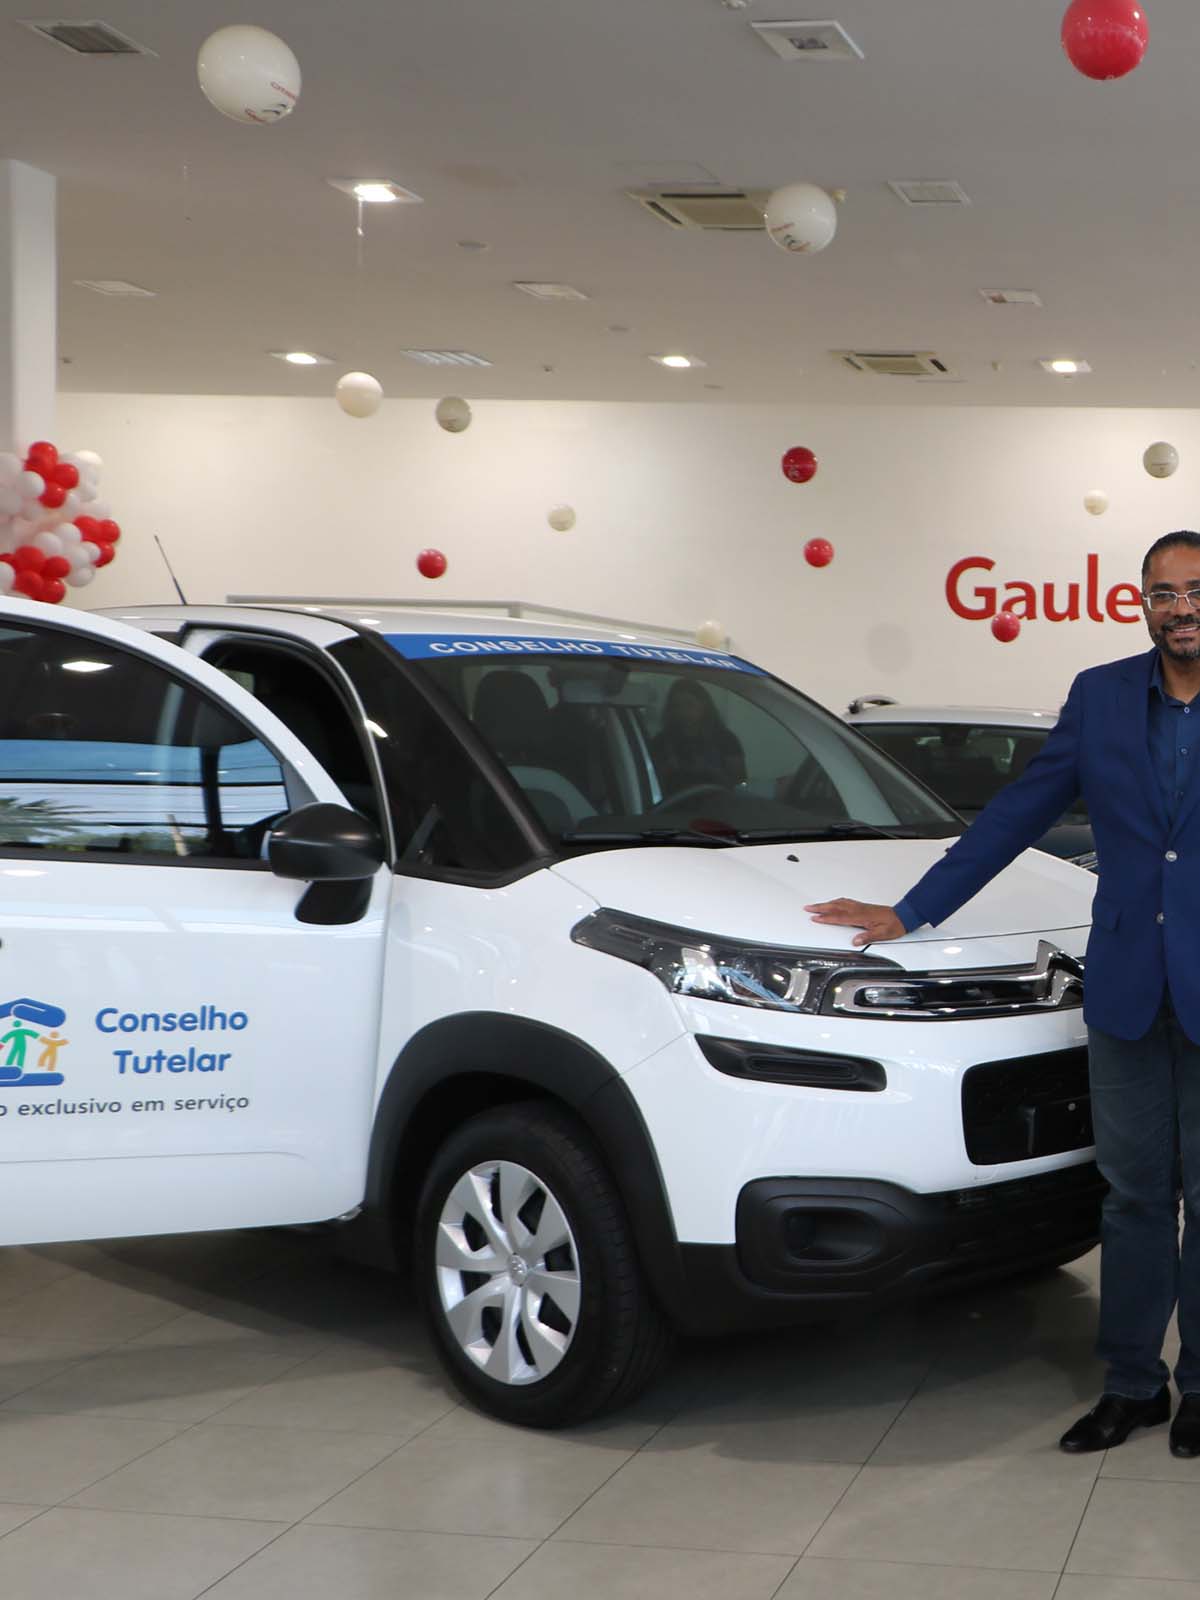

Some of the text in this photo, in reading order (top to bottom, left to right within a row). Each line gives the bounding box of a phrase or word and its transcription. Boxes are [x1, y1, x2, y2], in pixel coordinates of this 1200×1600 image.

[430, 639, 743, 671] CONSELHO TUTELAR
[95, 1004, 249, 1033] Conselho
[113, 1047, 231, 1074] Tutelar
[18, 1097, 122, 1116] exclusivo
[131, 1100, 165, 1113] em
[174, 1093, 249, 1113] serviço
